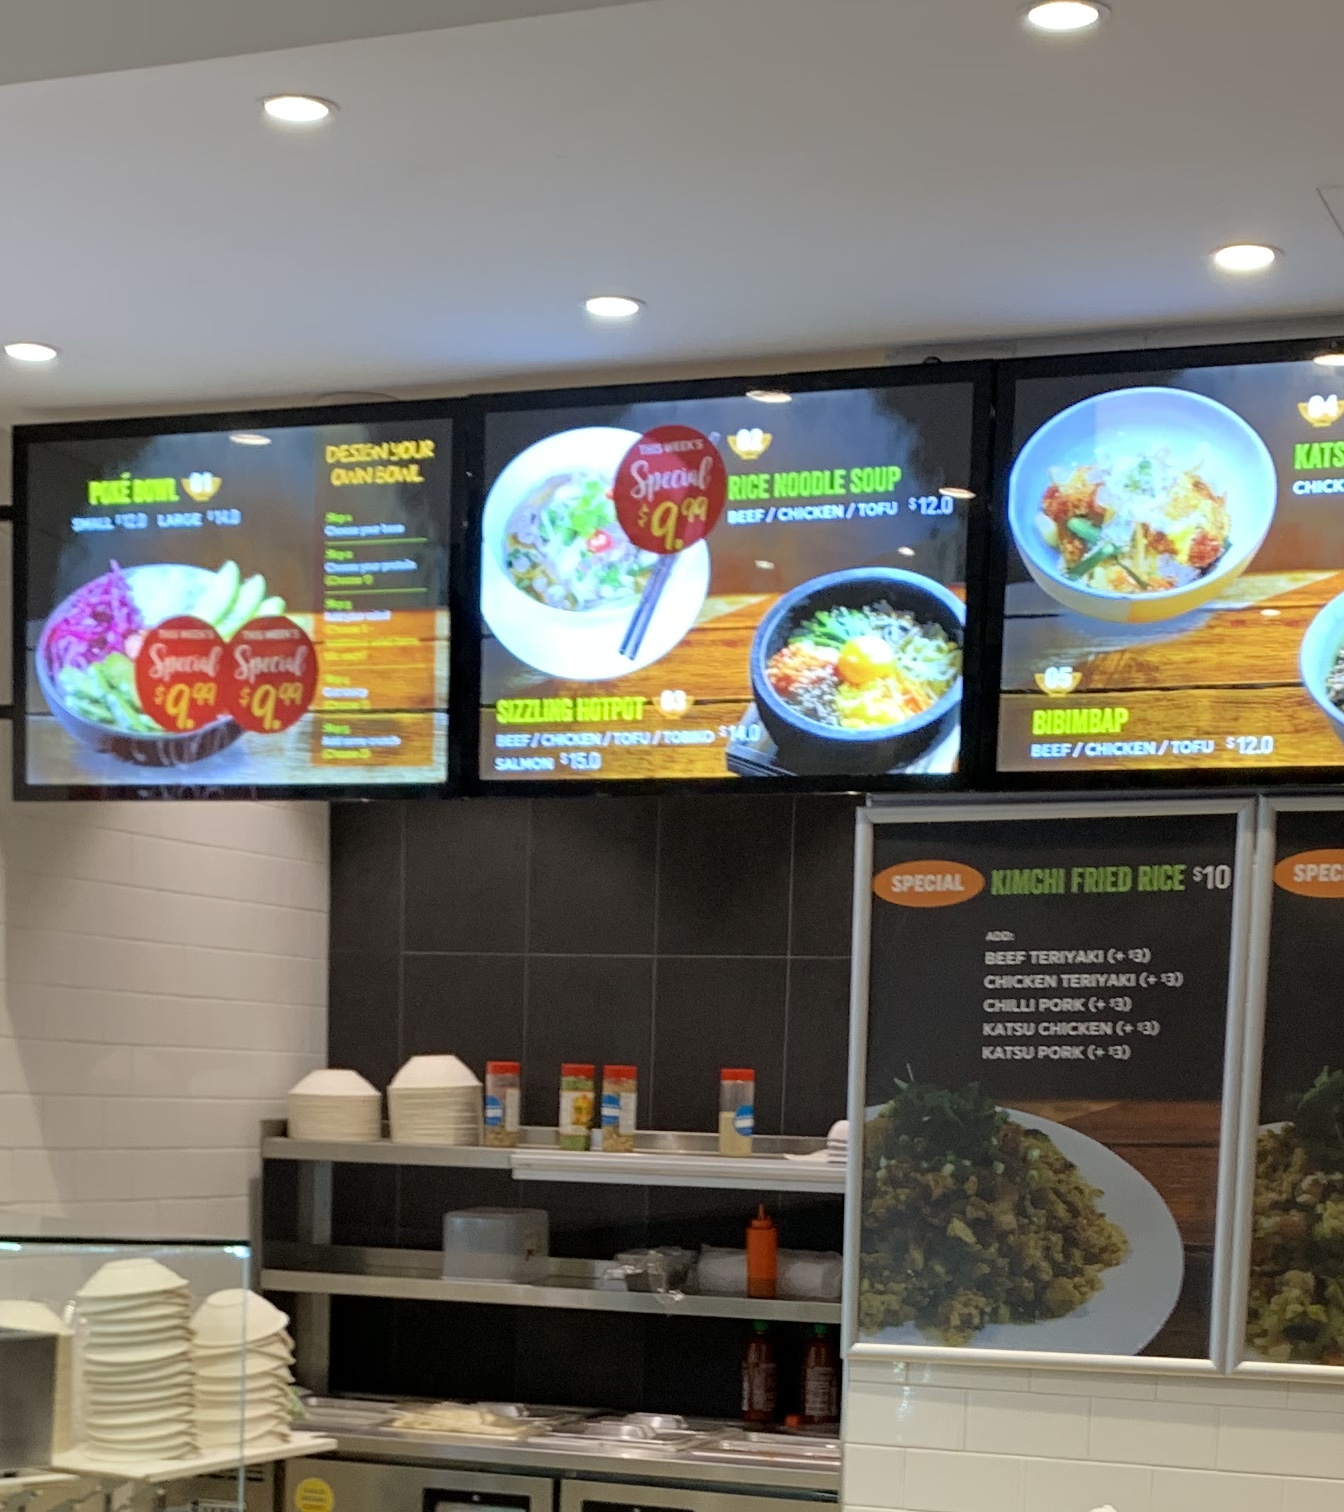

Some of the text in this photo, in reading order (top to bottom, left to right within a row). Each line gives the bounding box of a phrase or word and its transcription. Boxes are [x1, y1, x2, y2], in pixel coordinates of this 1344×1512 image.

[629, 455, 714, 502] Special
[727, 465, 902, 501] RICE NOODLE SOUP
[776, 504, 845, 522] CHICKEN
[856, 501, 898, 517] TOFU
[908, 495, 954, 515] $12.0
[148, 643, 223, 682] Special
[234, 644, 309, 684] Special
[495, 696, 647, 724] SIZZLING HOTPOT
[1032, 707, 1129, 735] BIBIMBAP
[1030, 742, 1071, 758] BEEF
[1084, 741, 1156, 756] CHICKEN
[1170, 740, 1215, 754] TOFU
[1225, 735, 1274, 754] $12.0
[891, 873, 965, 893] SPECIAL
[991, 865, 1231, 894] KIMCHI FRIED RICE $10
[985, 951, 1027, 965] BEEF
[1030, 950, 1104, 965] TERIYAKI
[984, 974, 1056, 989] CHICKEN
[1060, 974, 1136, 988] TERIYAKI
[983, 998, 1035, 1013] CHILLI
[1038, 998, 1085, 1012] PORK
[983, 1022, 1035, 1037] KATSU
[1038, 1022, 1112, 1036] CHICKEN
[982, 1046, 1035, 1060] KATSU
[1038, 1045, 1084, 1059] PORK
